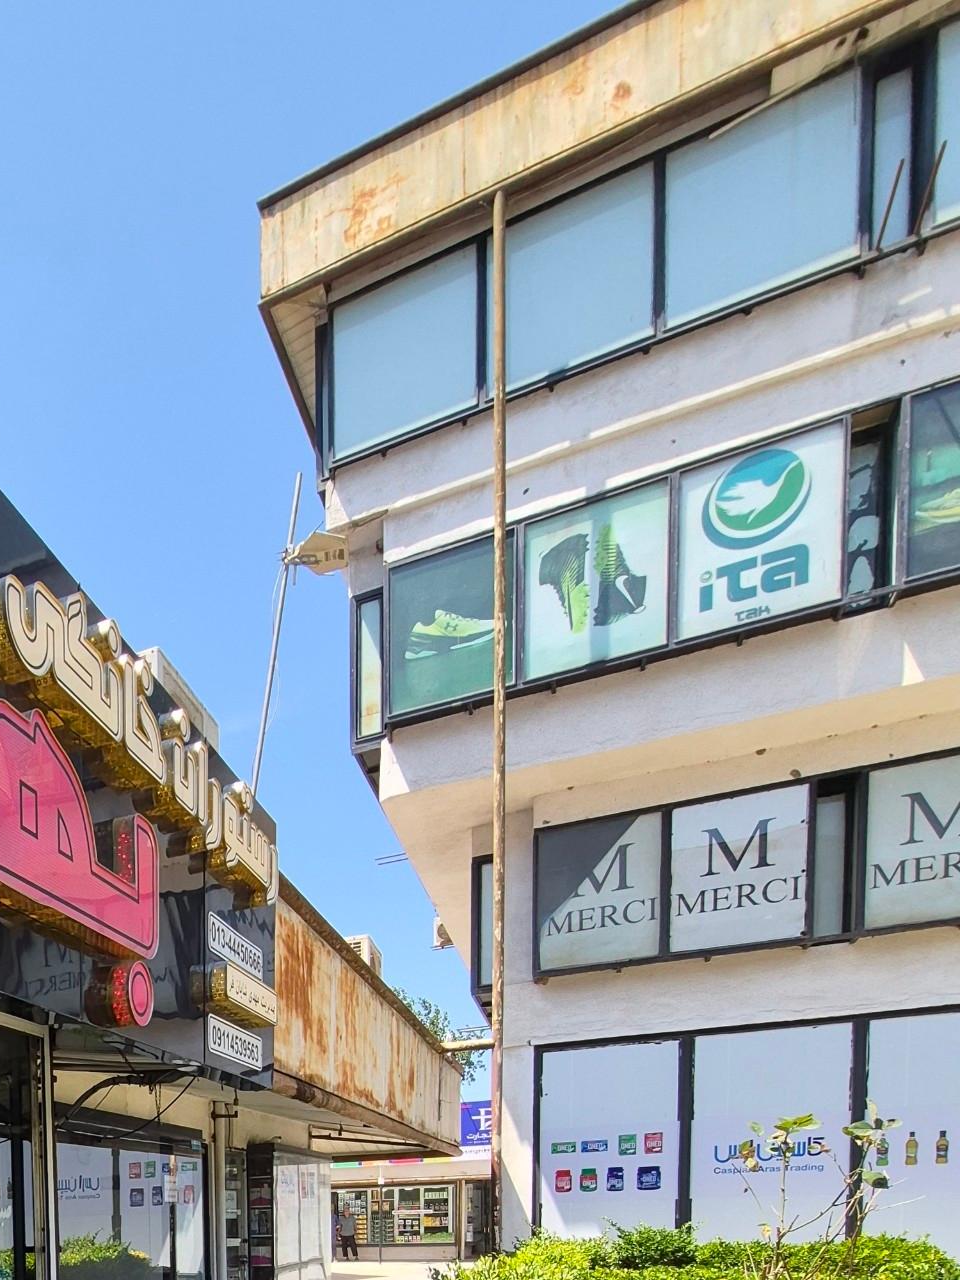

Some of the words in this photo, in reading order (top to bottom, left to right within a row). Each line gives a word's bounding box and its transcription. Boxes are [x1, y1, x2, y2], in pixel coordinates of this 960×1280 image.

[4, 573, 167, 786] خانگی
[172, 711, 279, 906] رستوران
[898, 791, 960, 846] M
[569, 841, 636, 899] M
[700, 816, 777, 878] M
[545, 896, 658, 937] MERCI
[674, 875, 804, 917] MERCI
[211, 920, 261, 974] 013-44450666
[212, 1024, 259, 1063] 09114539563
[713, 1165, 757, 1175] Caspia
